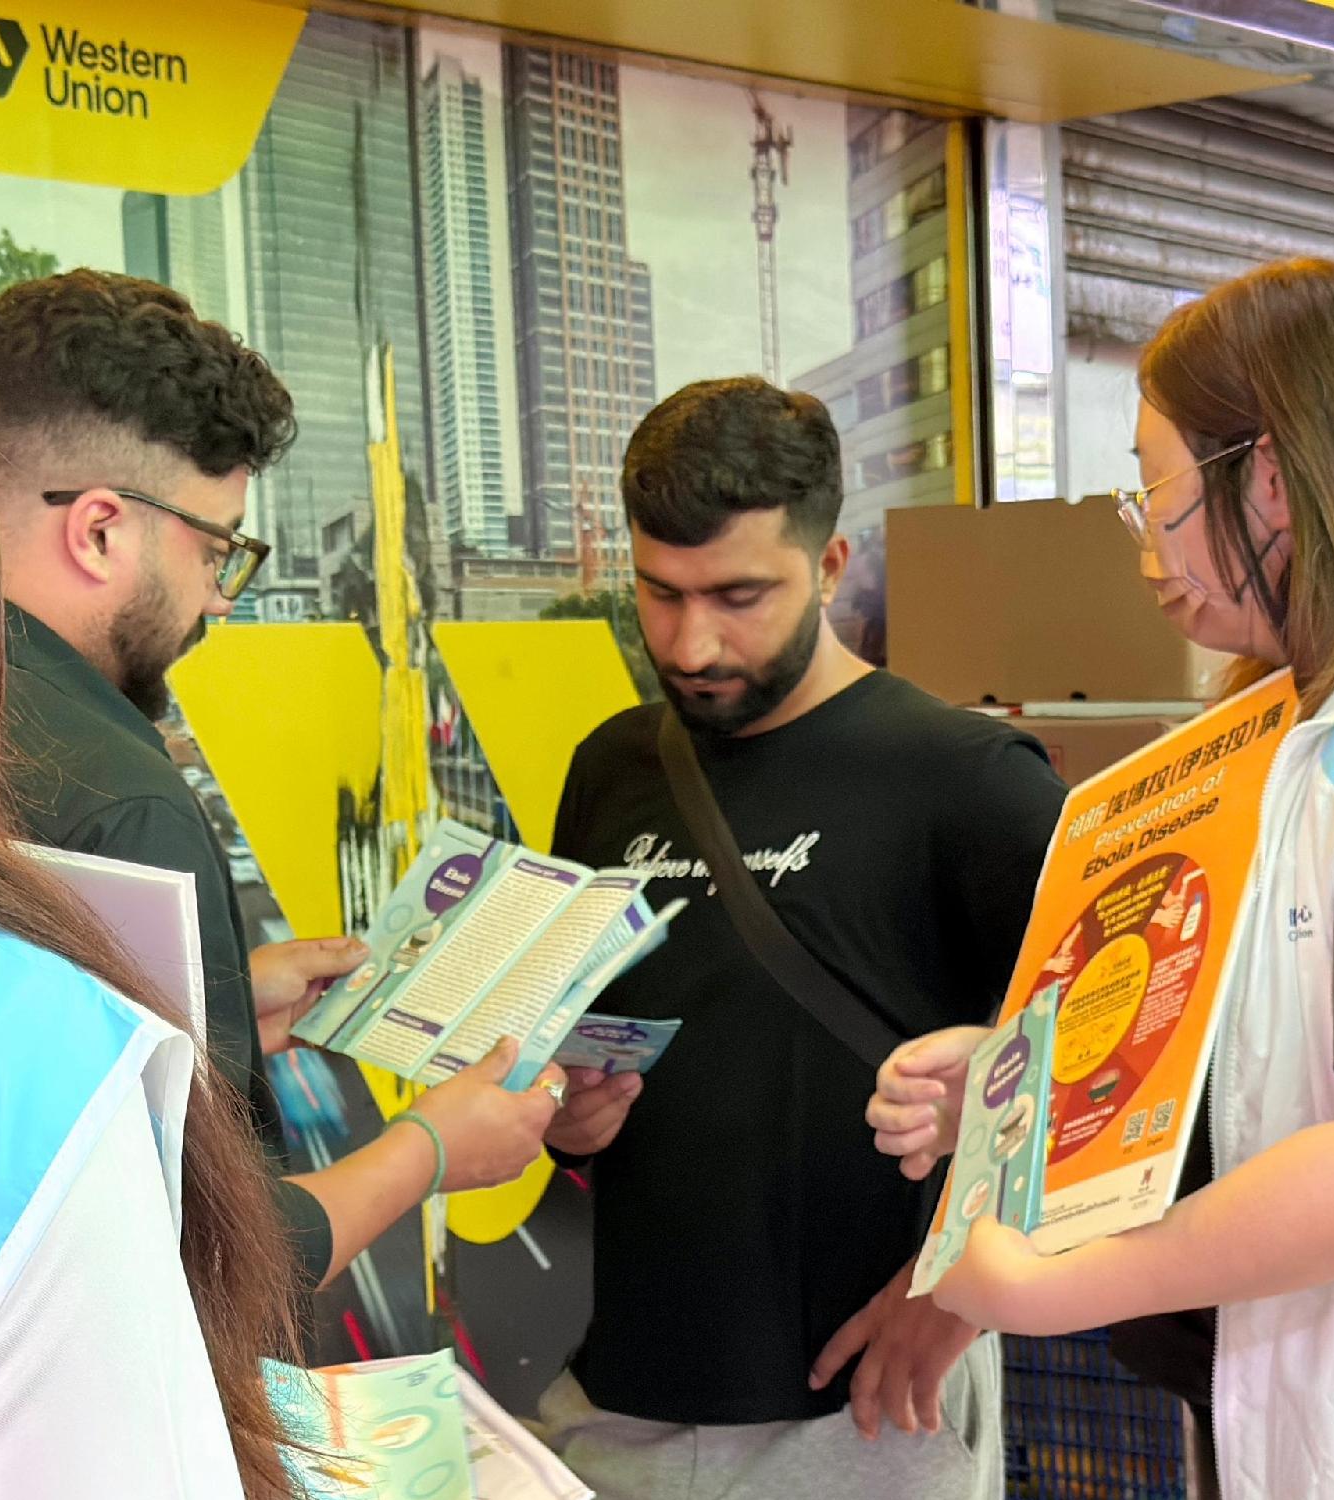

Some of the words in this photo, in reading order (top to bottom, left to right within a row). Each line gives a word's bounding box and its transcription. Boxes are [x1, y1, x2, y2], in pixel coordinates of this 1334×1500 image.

[40, 24, 188, 85] Western
[43, 66, 149, 119] Union
[1082, 841, 1134, 880] Ebola
[1137, 797, 1220, 851] Disease
[1094, 787, 1198, 852] Prevention
[1202, 764, 1227, 795] of
